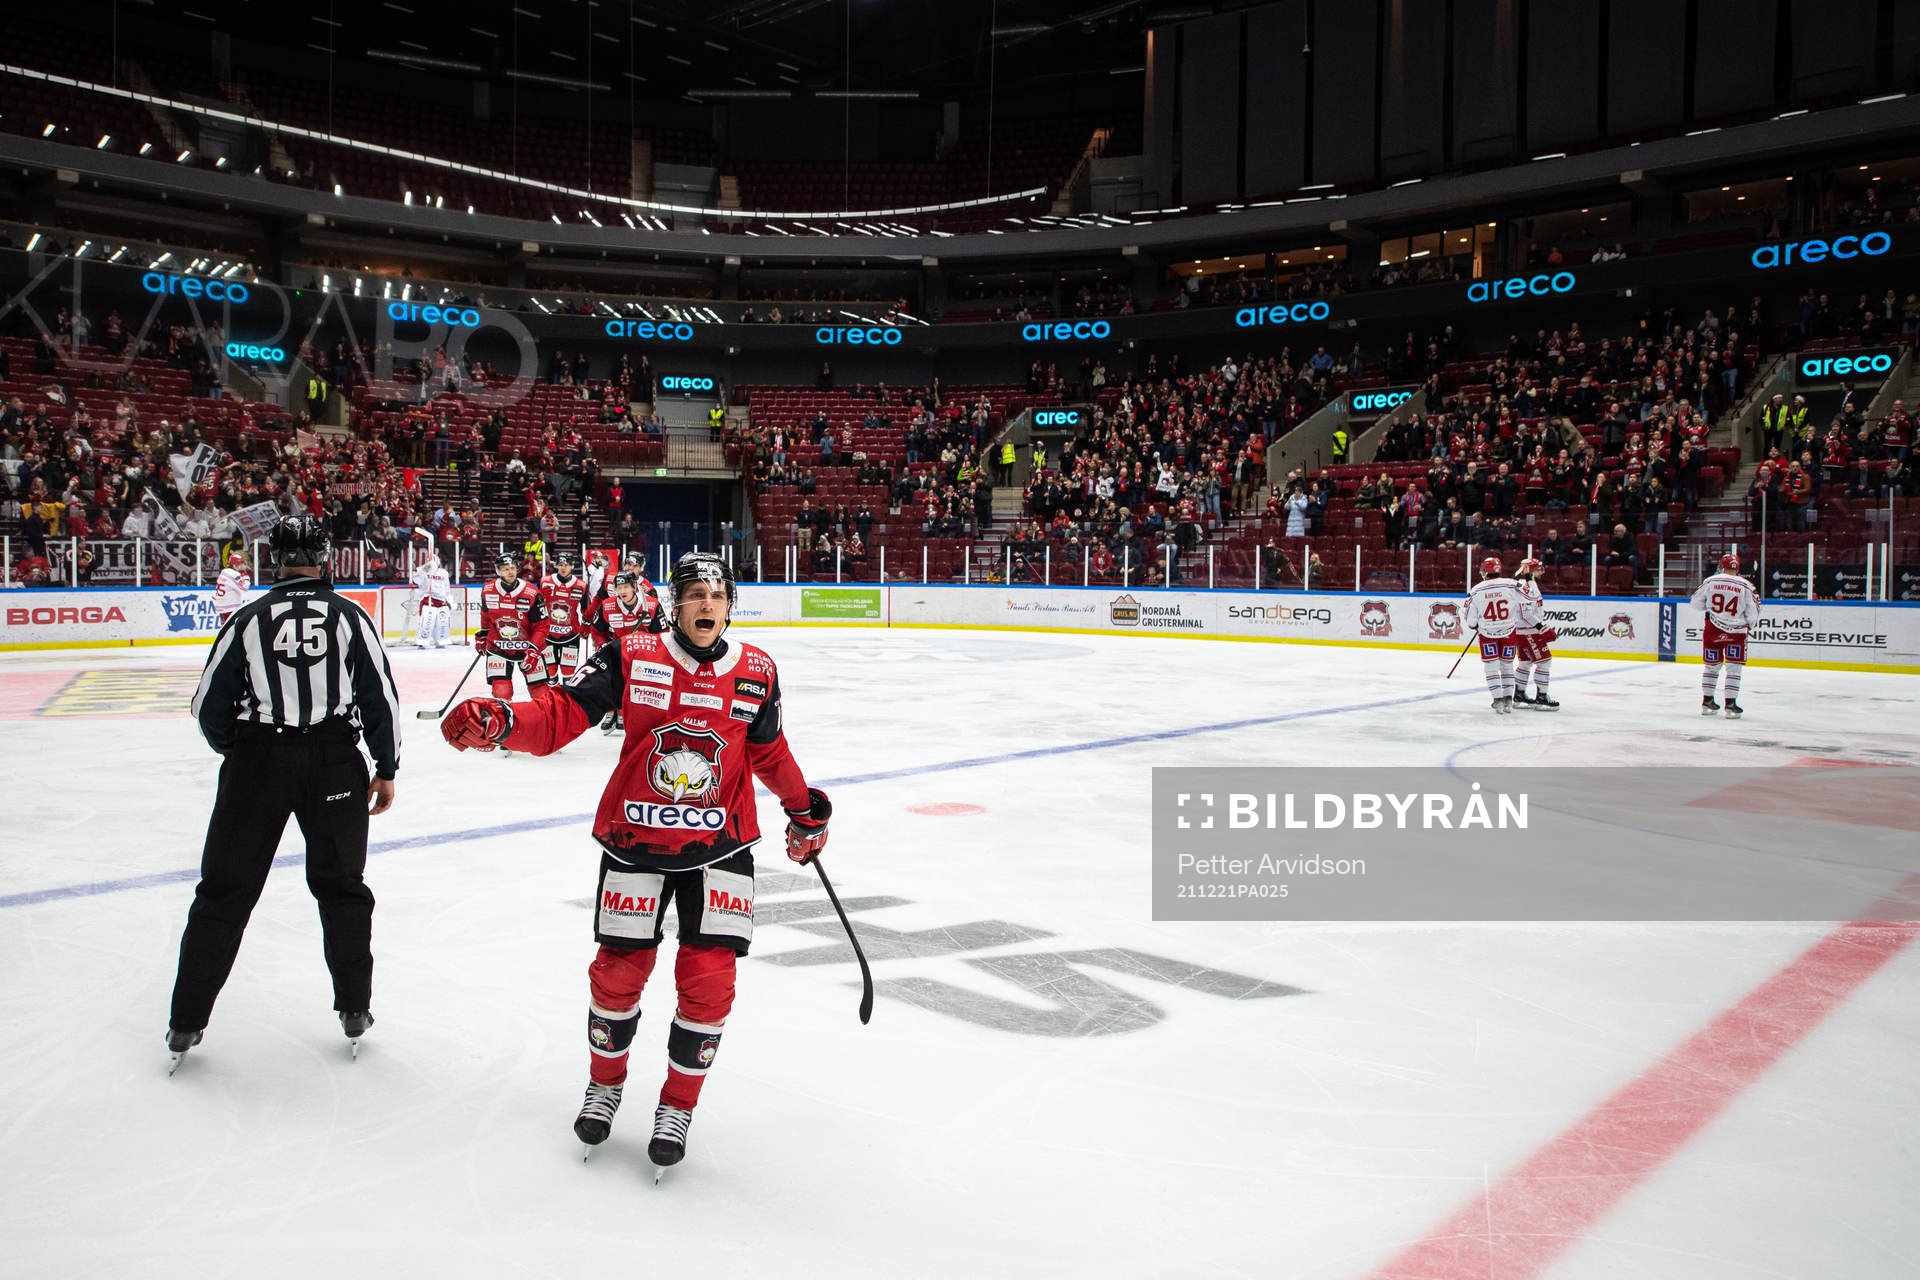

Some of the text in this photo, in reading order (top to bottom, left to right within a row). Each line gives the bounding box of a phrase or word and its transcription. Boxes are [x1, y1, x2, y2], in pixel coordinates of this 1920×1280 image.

[1752, 231, 1891, 269] areco
[142, 272, 248, 303] areco
[1467, 272, 1576, 302] areco
[387, 301, 481, 328] areco
[1235, 302, 1330, 327] areco
[605, 320, 694, 341] areco
[816, 326, 902, 345] areco
[1022, 320, 1111, 341] areco
[226, 343, 285, 362] areco
[1803, 354, 1892, 377] areco
[662, 376, 713, 390] areco
[1035, 411, 1079, 425] arec
[1142, 604, 1181, 616] NORDANÅ
[1229, 604, 1331, 624] sandberg
[1483, 599, 1509, 621] 46
[1710, 593, 1740, 617] 94
[7, 607, 126, 625] BORGA
[1142, 618, 1204, 628] GRUSTERMINAL
[1755, 617, 1813, 630] ALMÖ
[550, 625, 572, 634] reco
[1556, 627, 1605, 638] UNGDOM
[1662, 604, 1671, 650] CCM
[272, 616, 328, 658] 45
[626, 644, 657, 652] HOTEL
[634, 687, 666, 700] Prioritet
[326, 790, 351, 801] CCM
[625, 802, 724, 831] areco
[608, 910, 654, 918] STORMARKNAD
